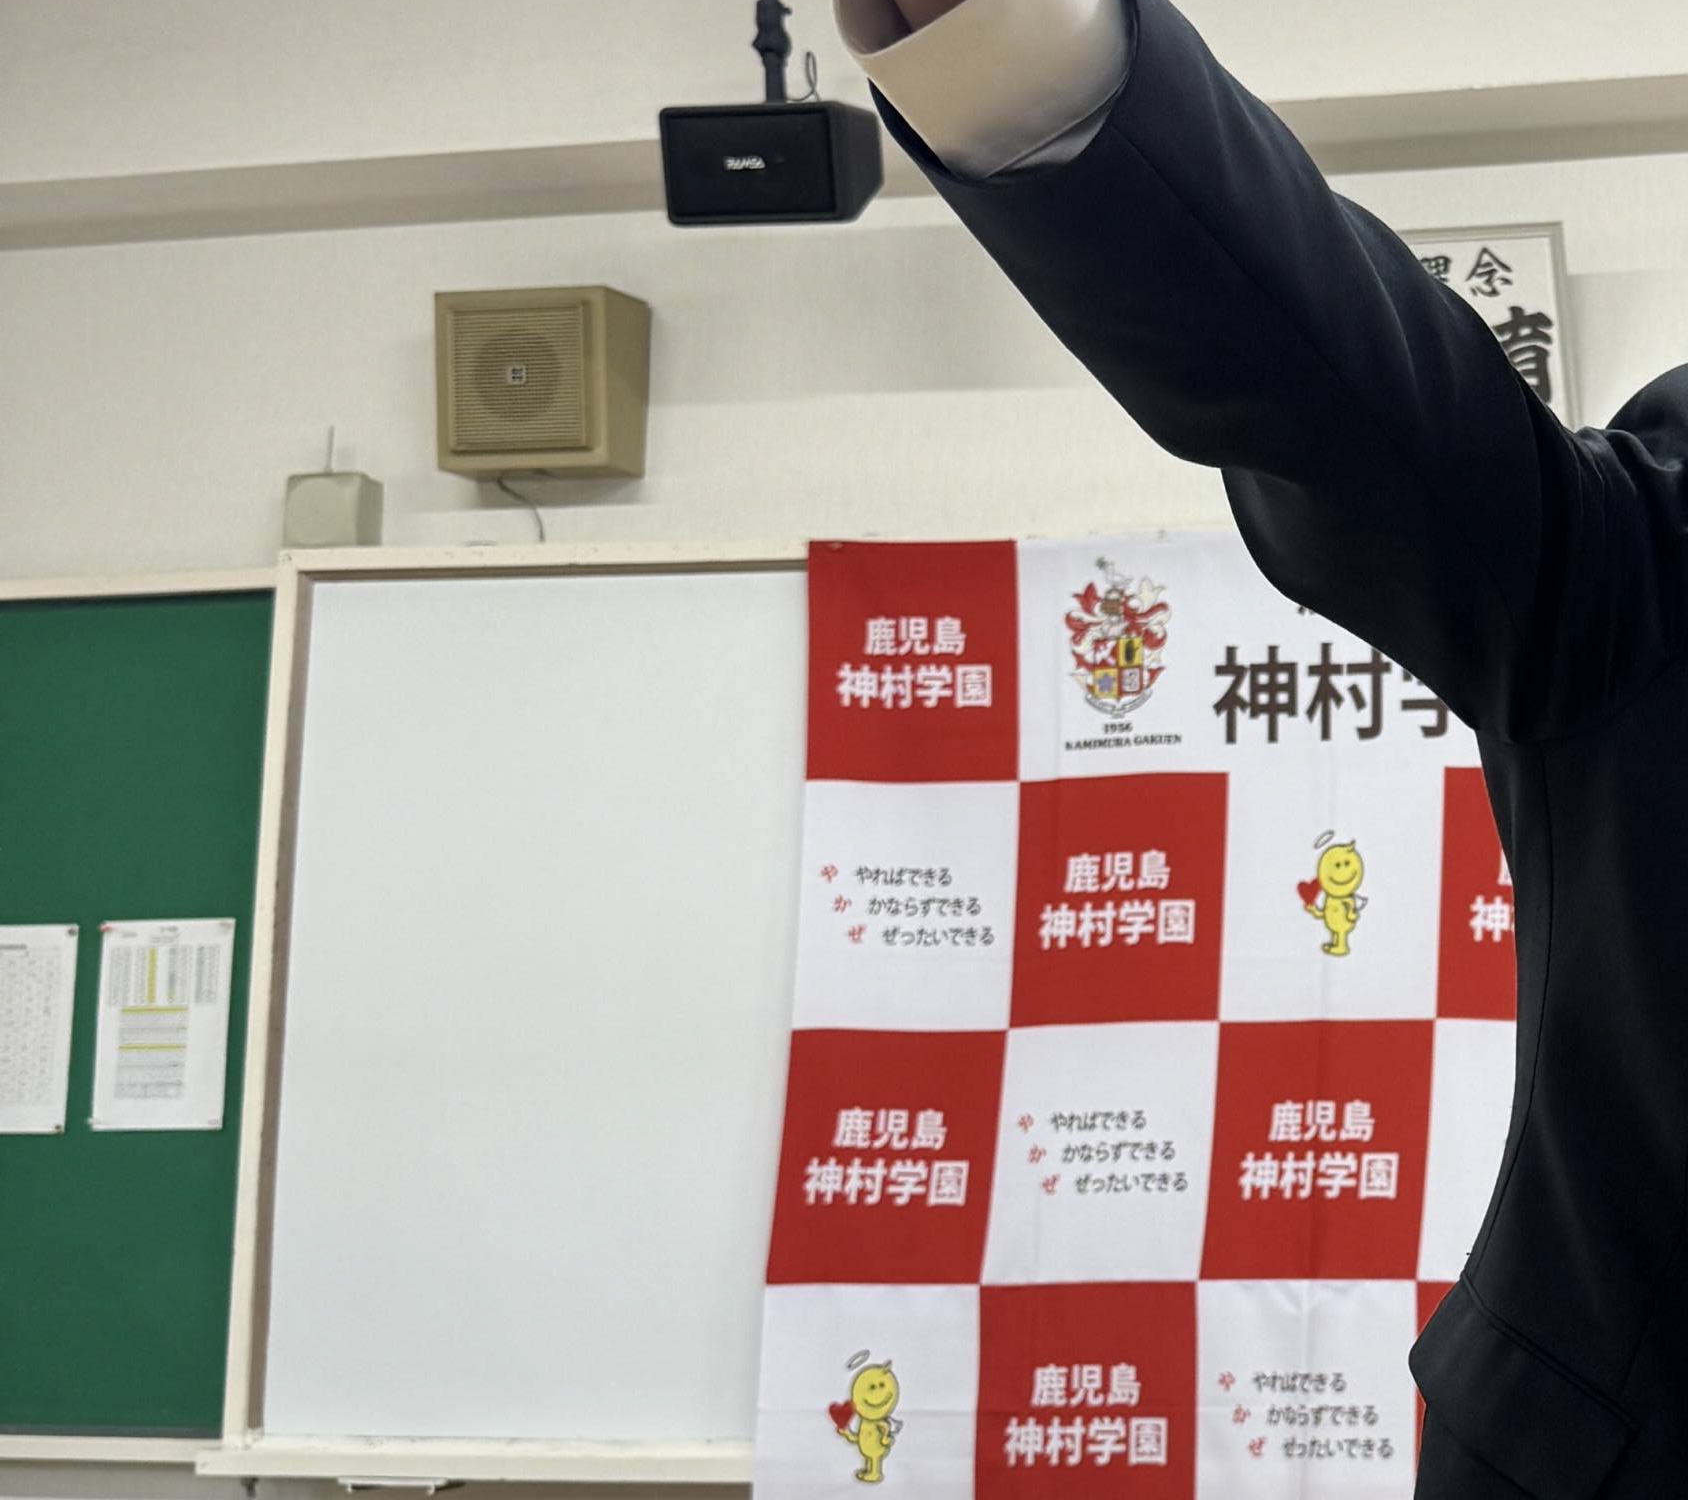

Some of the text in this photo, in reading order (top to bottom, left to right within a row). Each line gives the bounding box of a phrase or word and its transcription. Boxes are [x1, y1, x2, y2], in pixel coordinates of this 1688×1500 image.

[864, 616, 966, 656] 鹿児島
[836, 663, 992, 709] 神村学園
[1064, 849, 1171, 893] 鹿児島
[1039, 899, 1196, 950] 神村学園
[833, 1107, 947, 1150] 鹿児島
[1268, 1099, 1375, 1142] 鹿児島
[804, 1158, 970, 1206] 神村学園
[1238, 1151, 1400, 1200] 神村学園
[1031, 1363, 1142, 1407] 鹿児島
[1005, 1417, 1168, 1467] 神村学園
